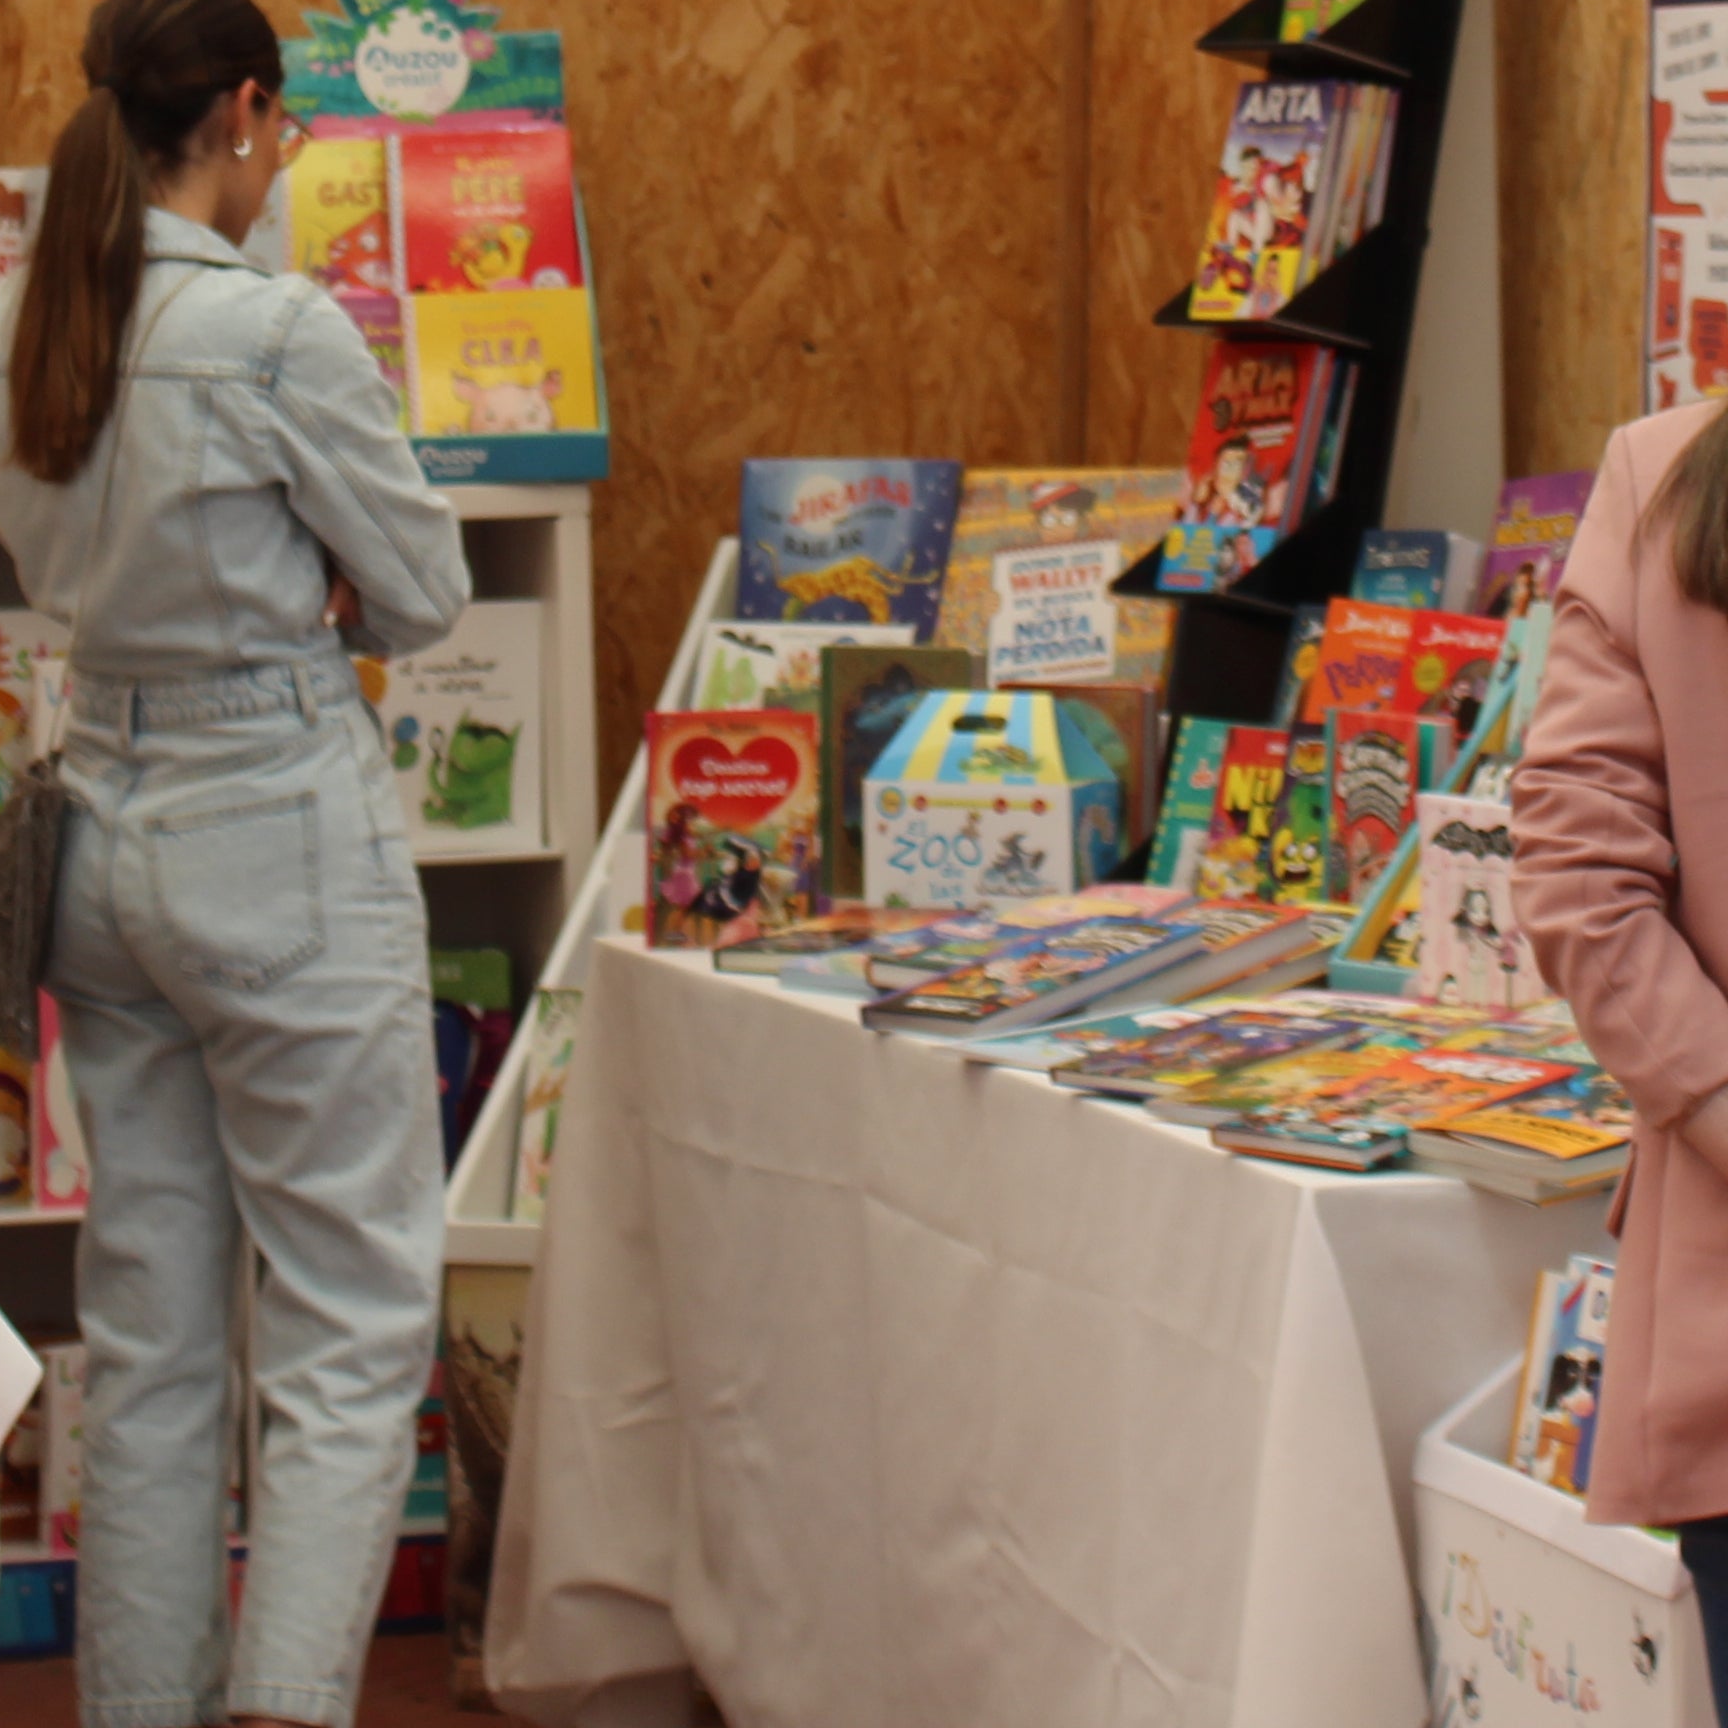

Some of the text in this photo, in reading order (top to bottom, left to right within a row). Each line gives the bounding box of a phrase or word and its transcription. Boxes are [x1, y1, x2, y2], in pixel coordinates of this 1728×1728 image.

[1238, 85, 1325, 125] ARTA
[1015, 614, 1092, 642] NOTA
[887, 833, 984, 874] ZOO
